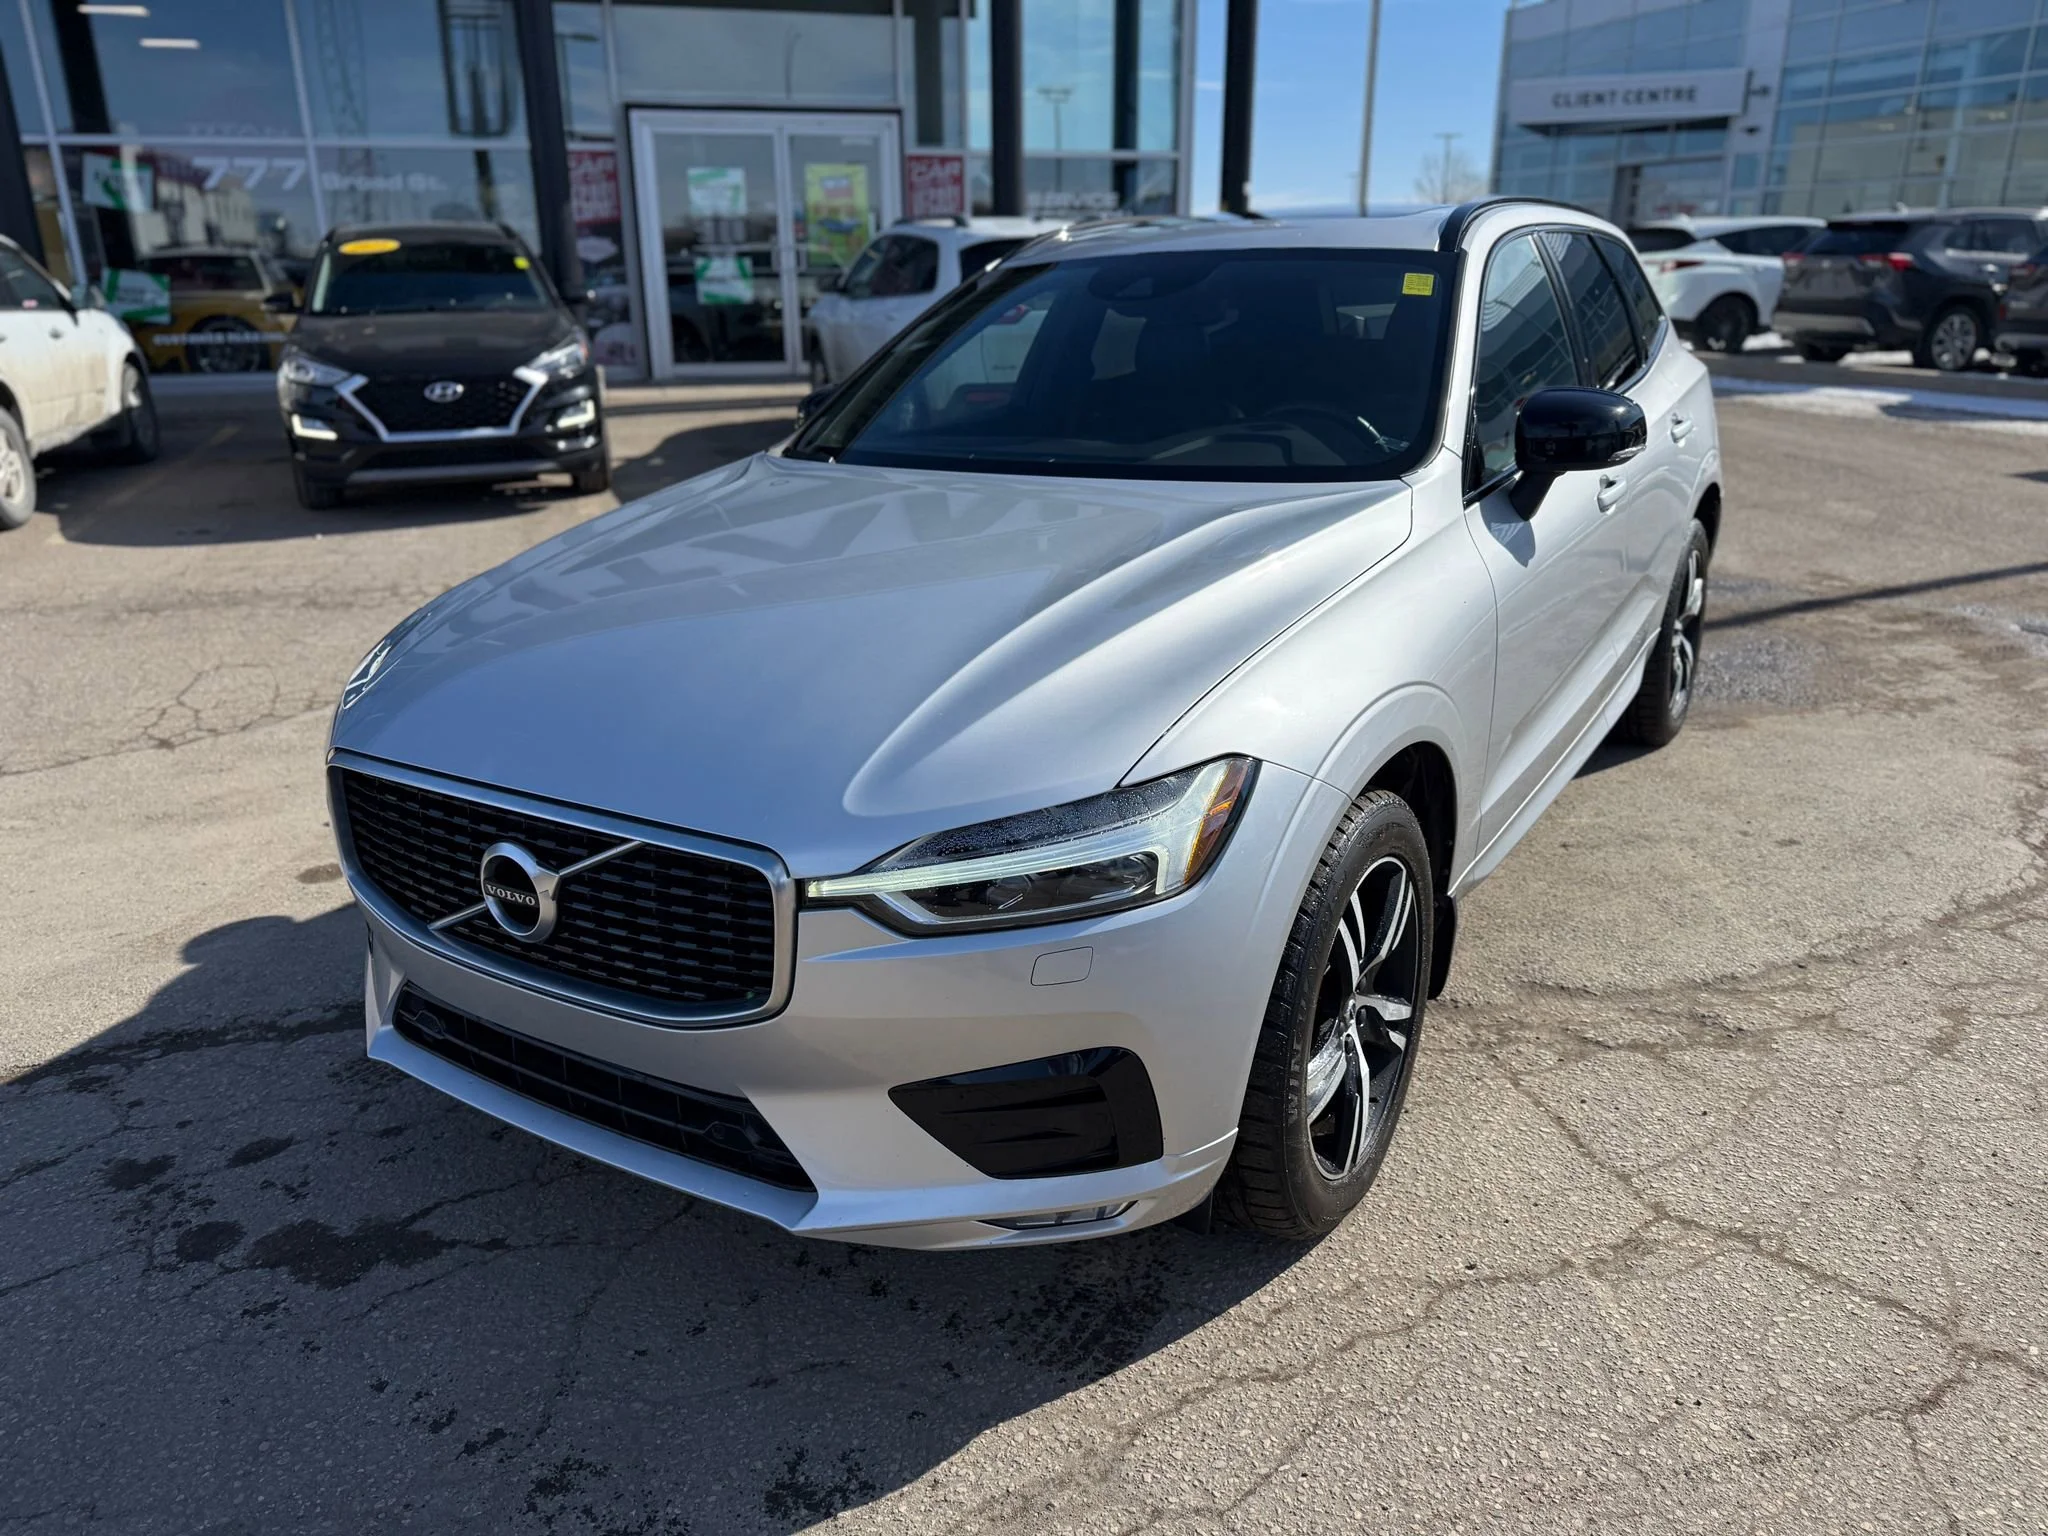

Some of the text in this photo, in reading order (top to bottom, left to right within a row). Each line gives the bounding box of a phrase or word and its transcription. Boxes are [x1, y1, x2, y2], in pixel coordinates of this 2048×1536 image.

[1553, 86, 1697, 108] CLIENT CENTRE
[193, 157, 306, 190] 777
[485, 884, 536, 906] VOLVO
